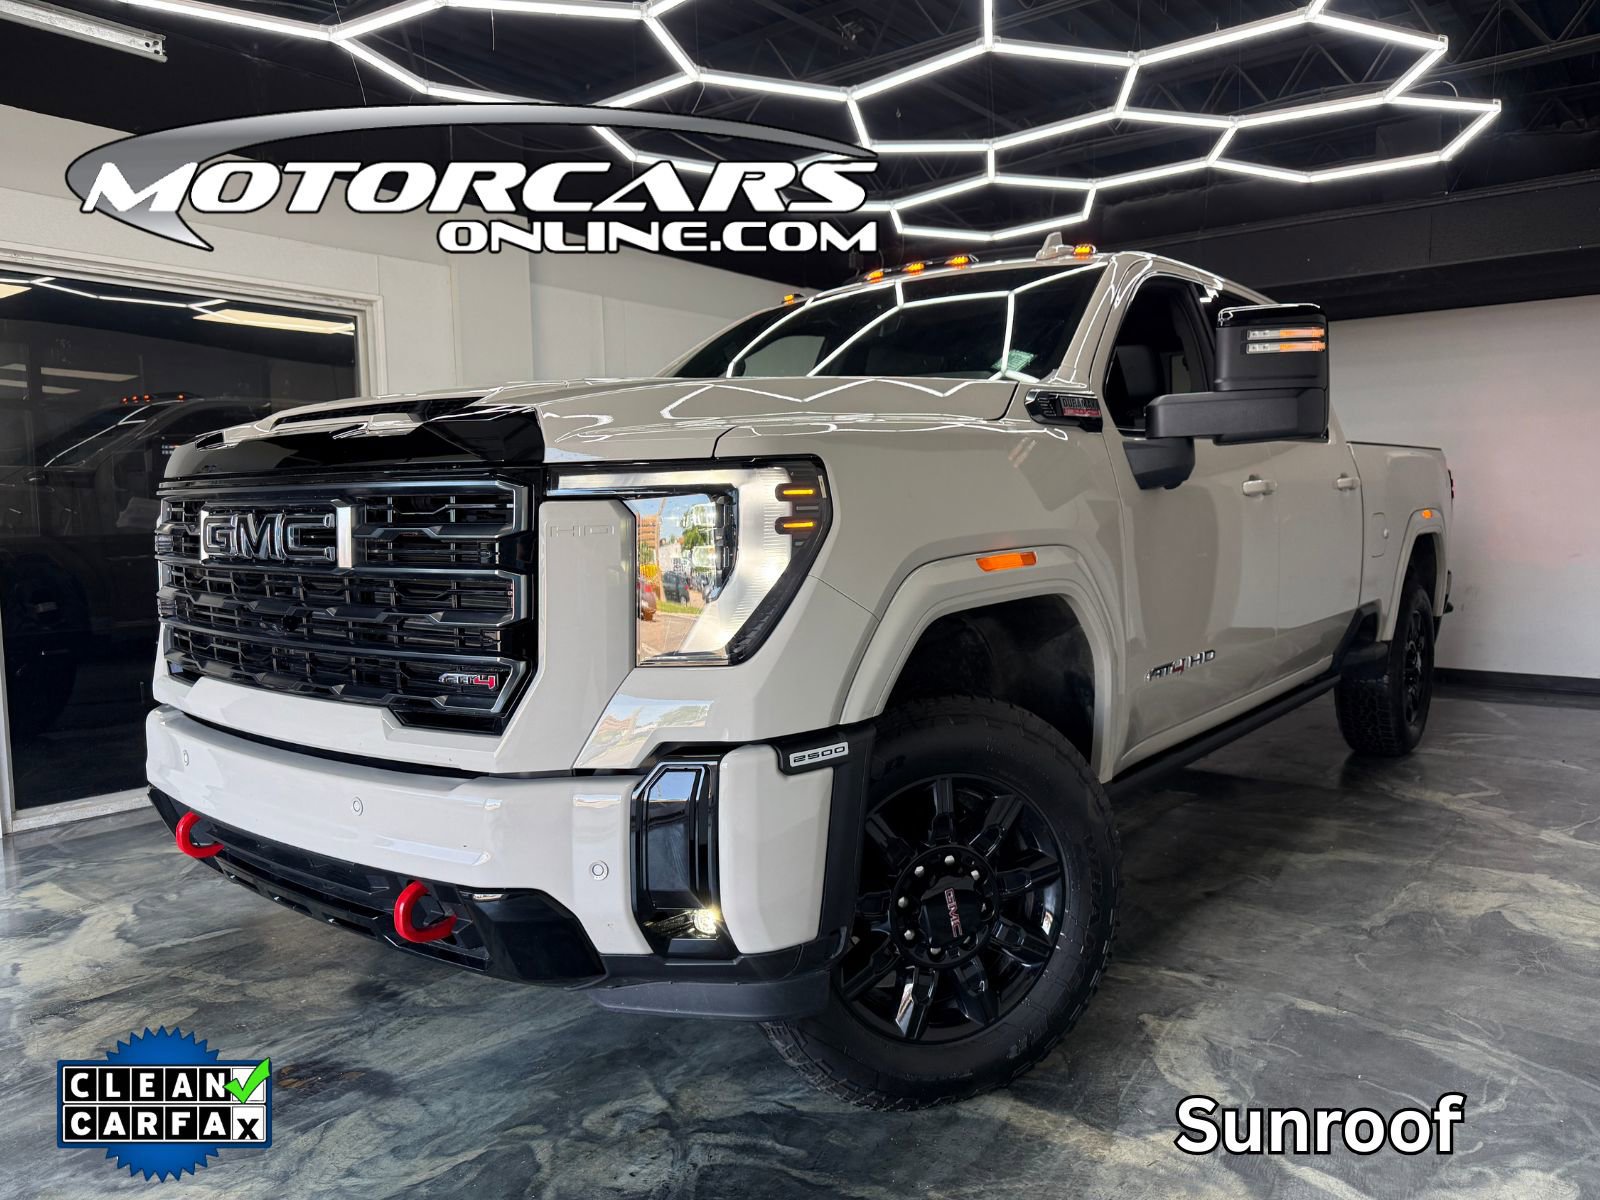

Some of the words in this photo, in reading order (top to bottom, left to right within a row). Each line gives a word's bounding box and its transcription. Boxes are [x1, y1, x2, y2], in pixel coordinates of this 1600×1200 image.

[203, 513, 336, 561] GMC
[793, 746, 845, 763] 2500
[945, 888, 962, 938] GMC
